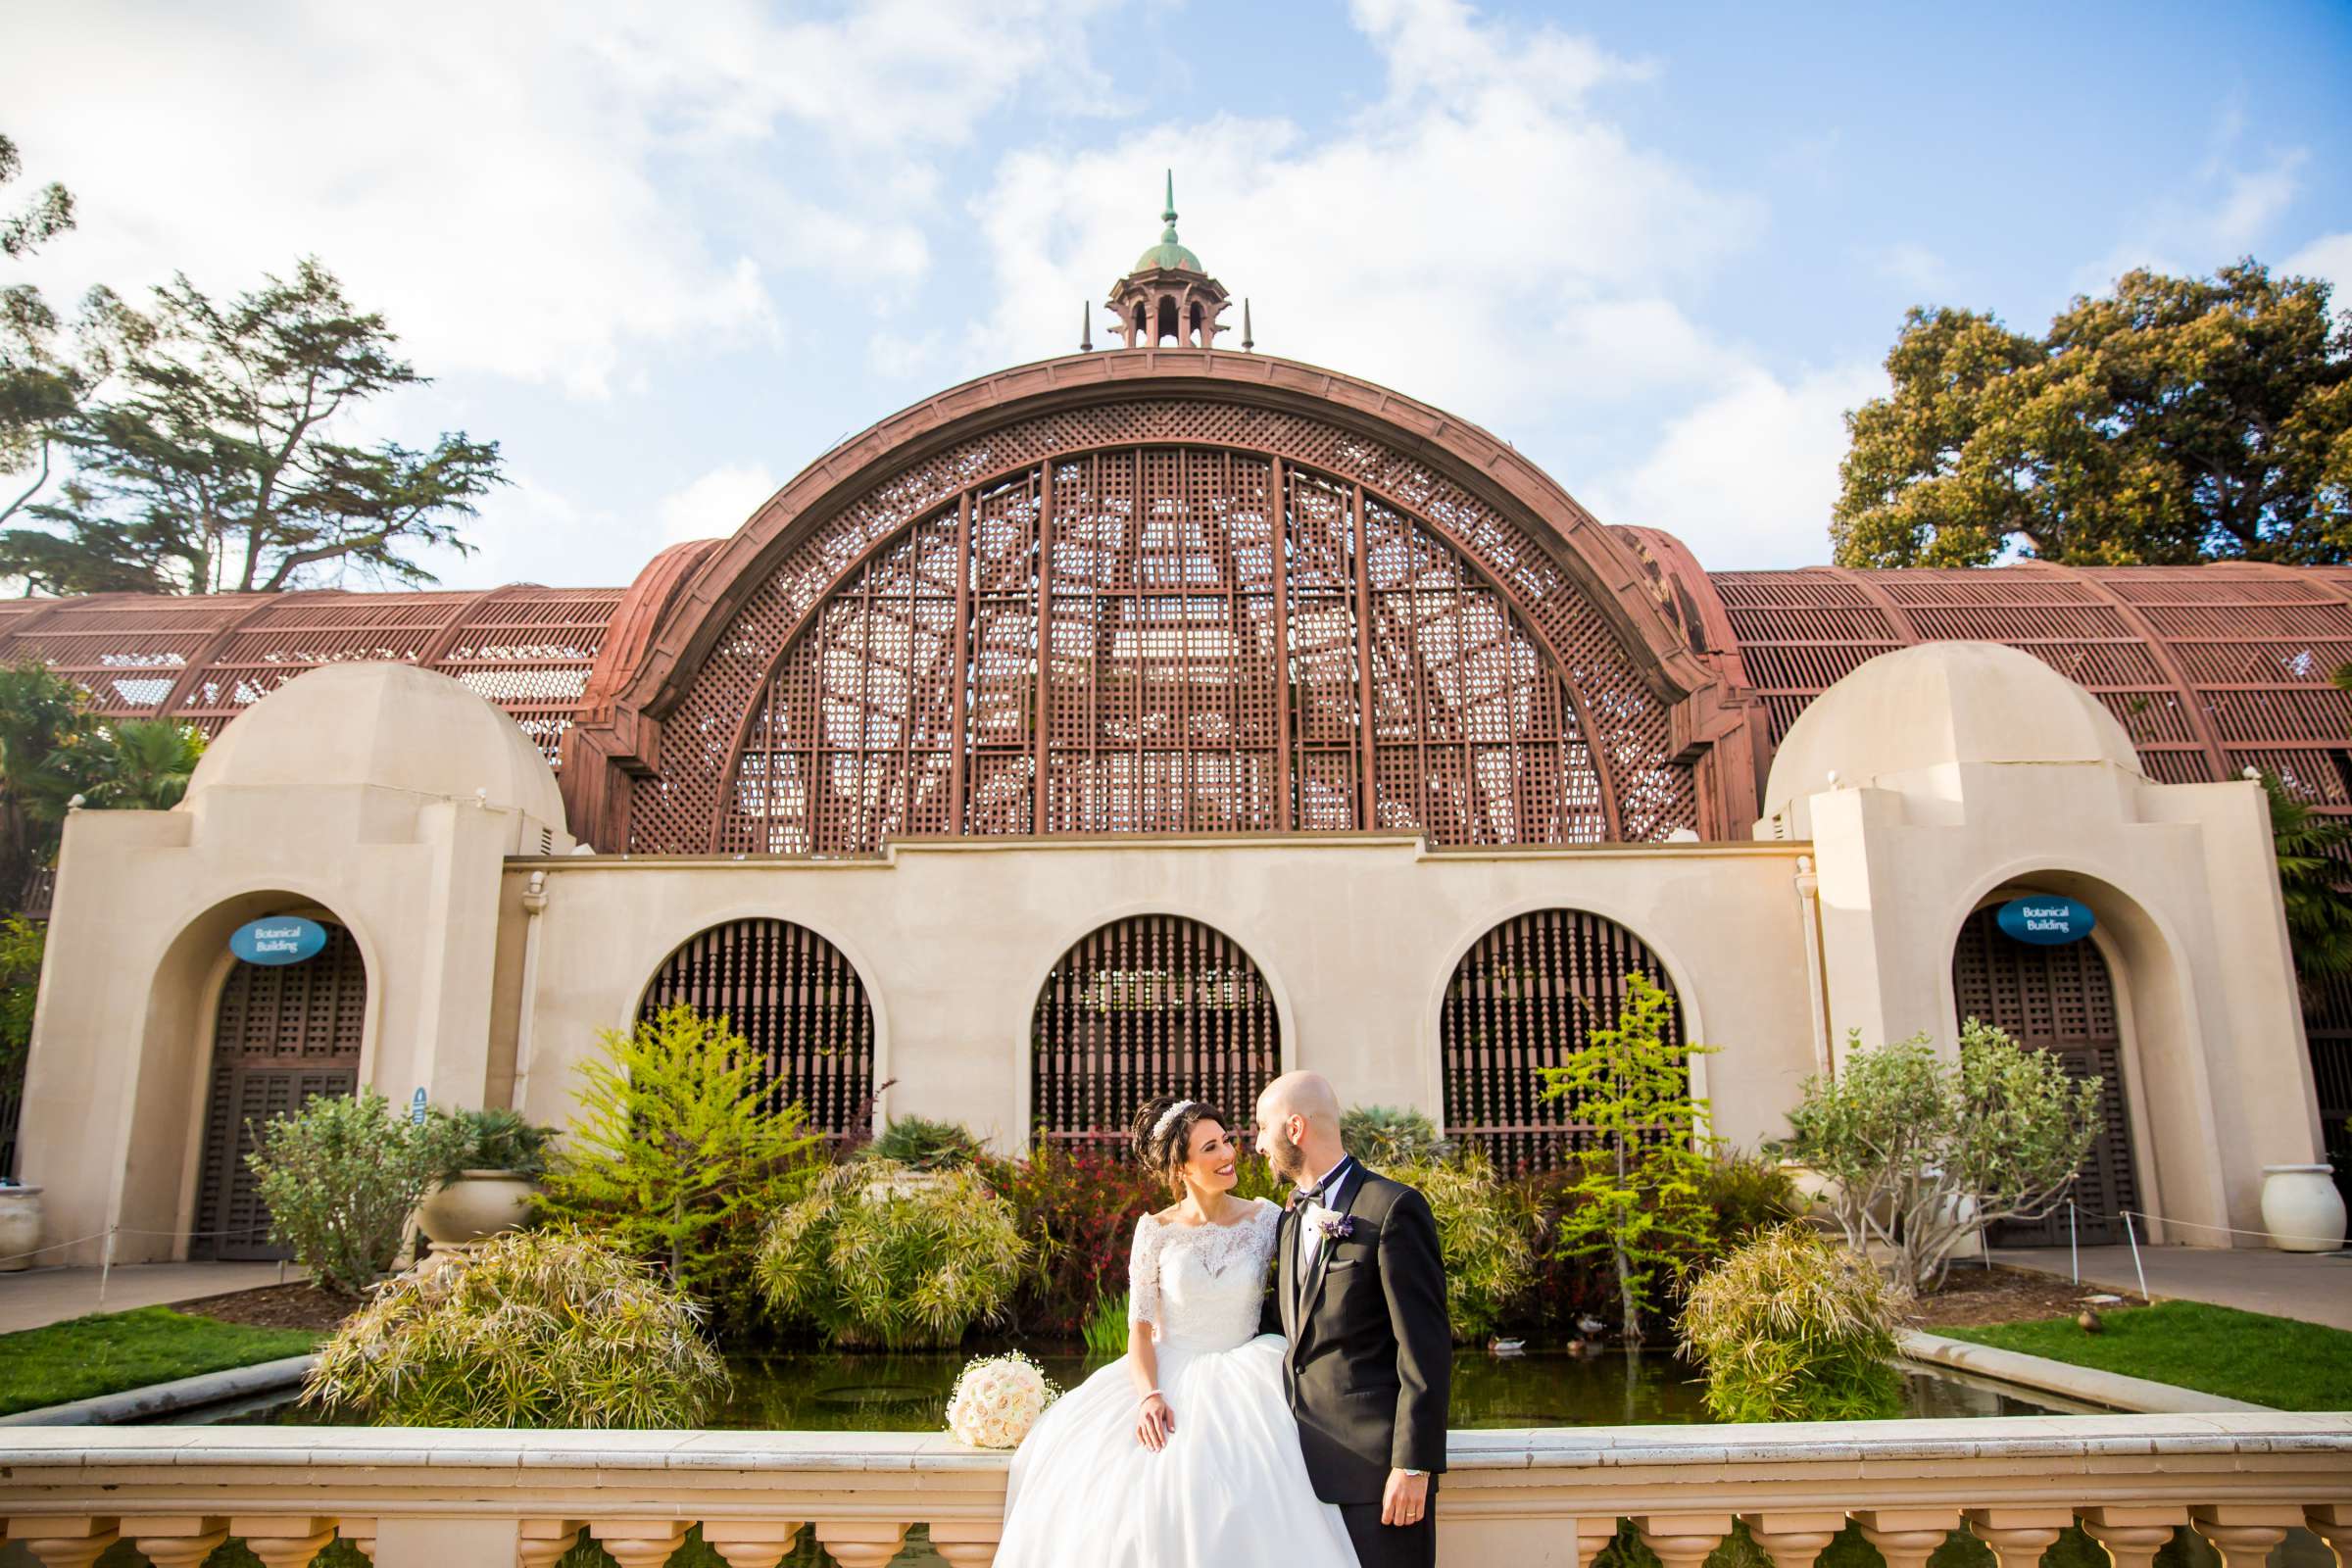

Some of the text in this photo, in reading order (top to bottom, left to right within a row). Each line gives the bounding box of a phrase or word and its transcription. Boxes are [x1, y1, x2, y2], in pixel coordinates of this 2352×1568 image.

[2023, 906, 2069, 917] Botanical
[255, 926, 301, 939] Botanical
[2027, 919, 2069, 933] Building
[256, 940, 298, 954] Building
